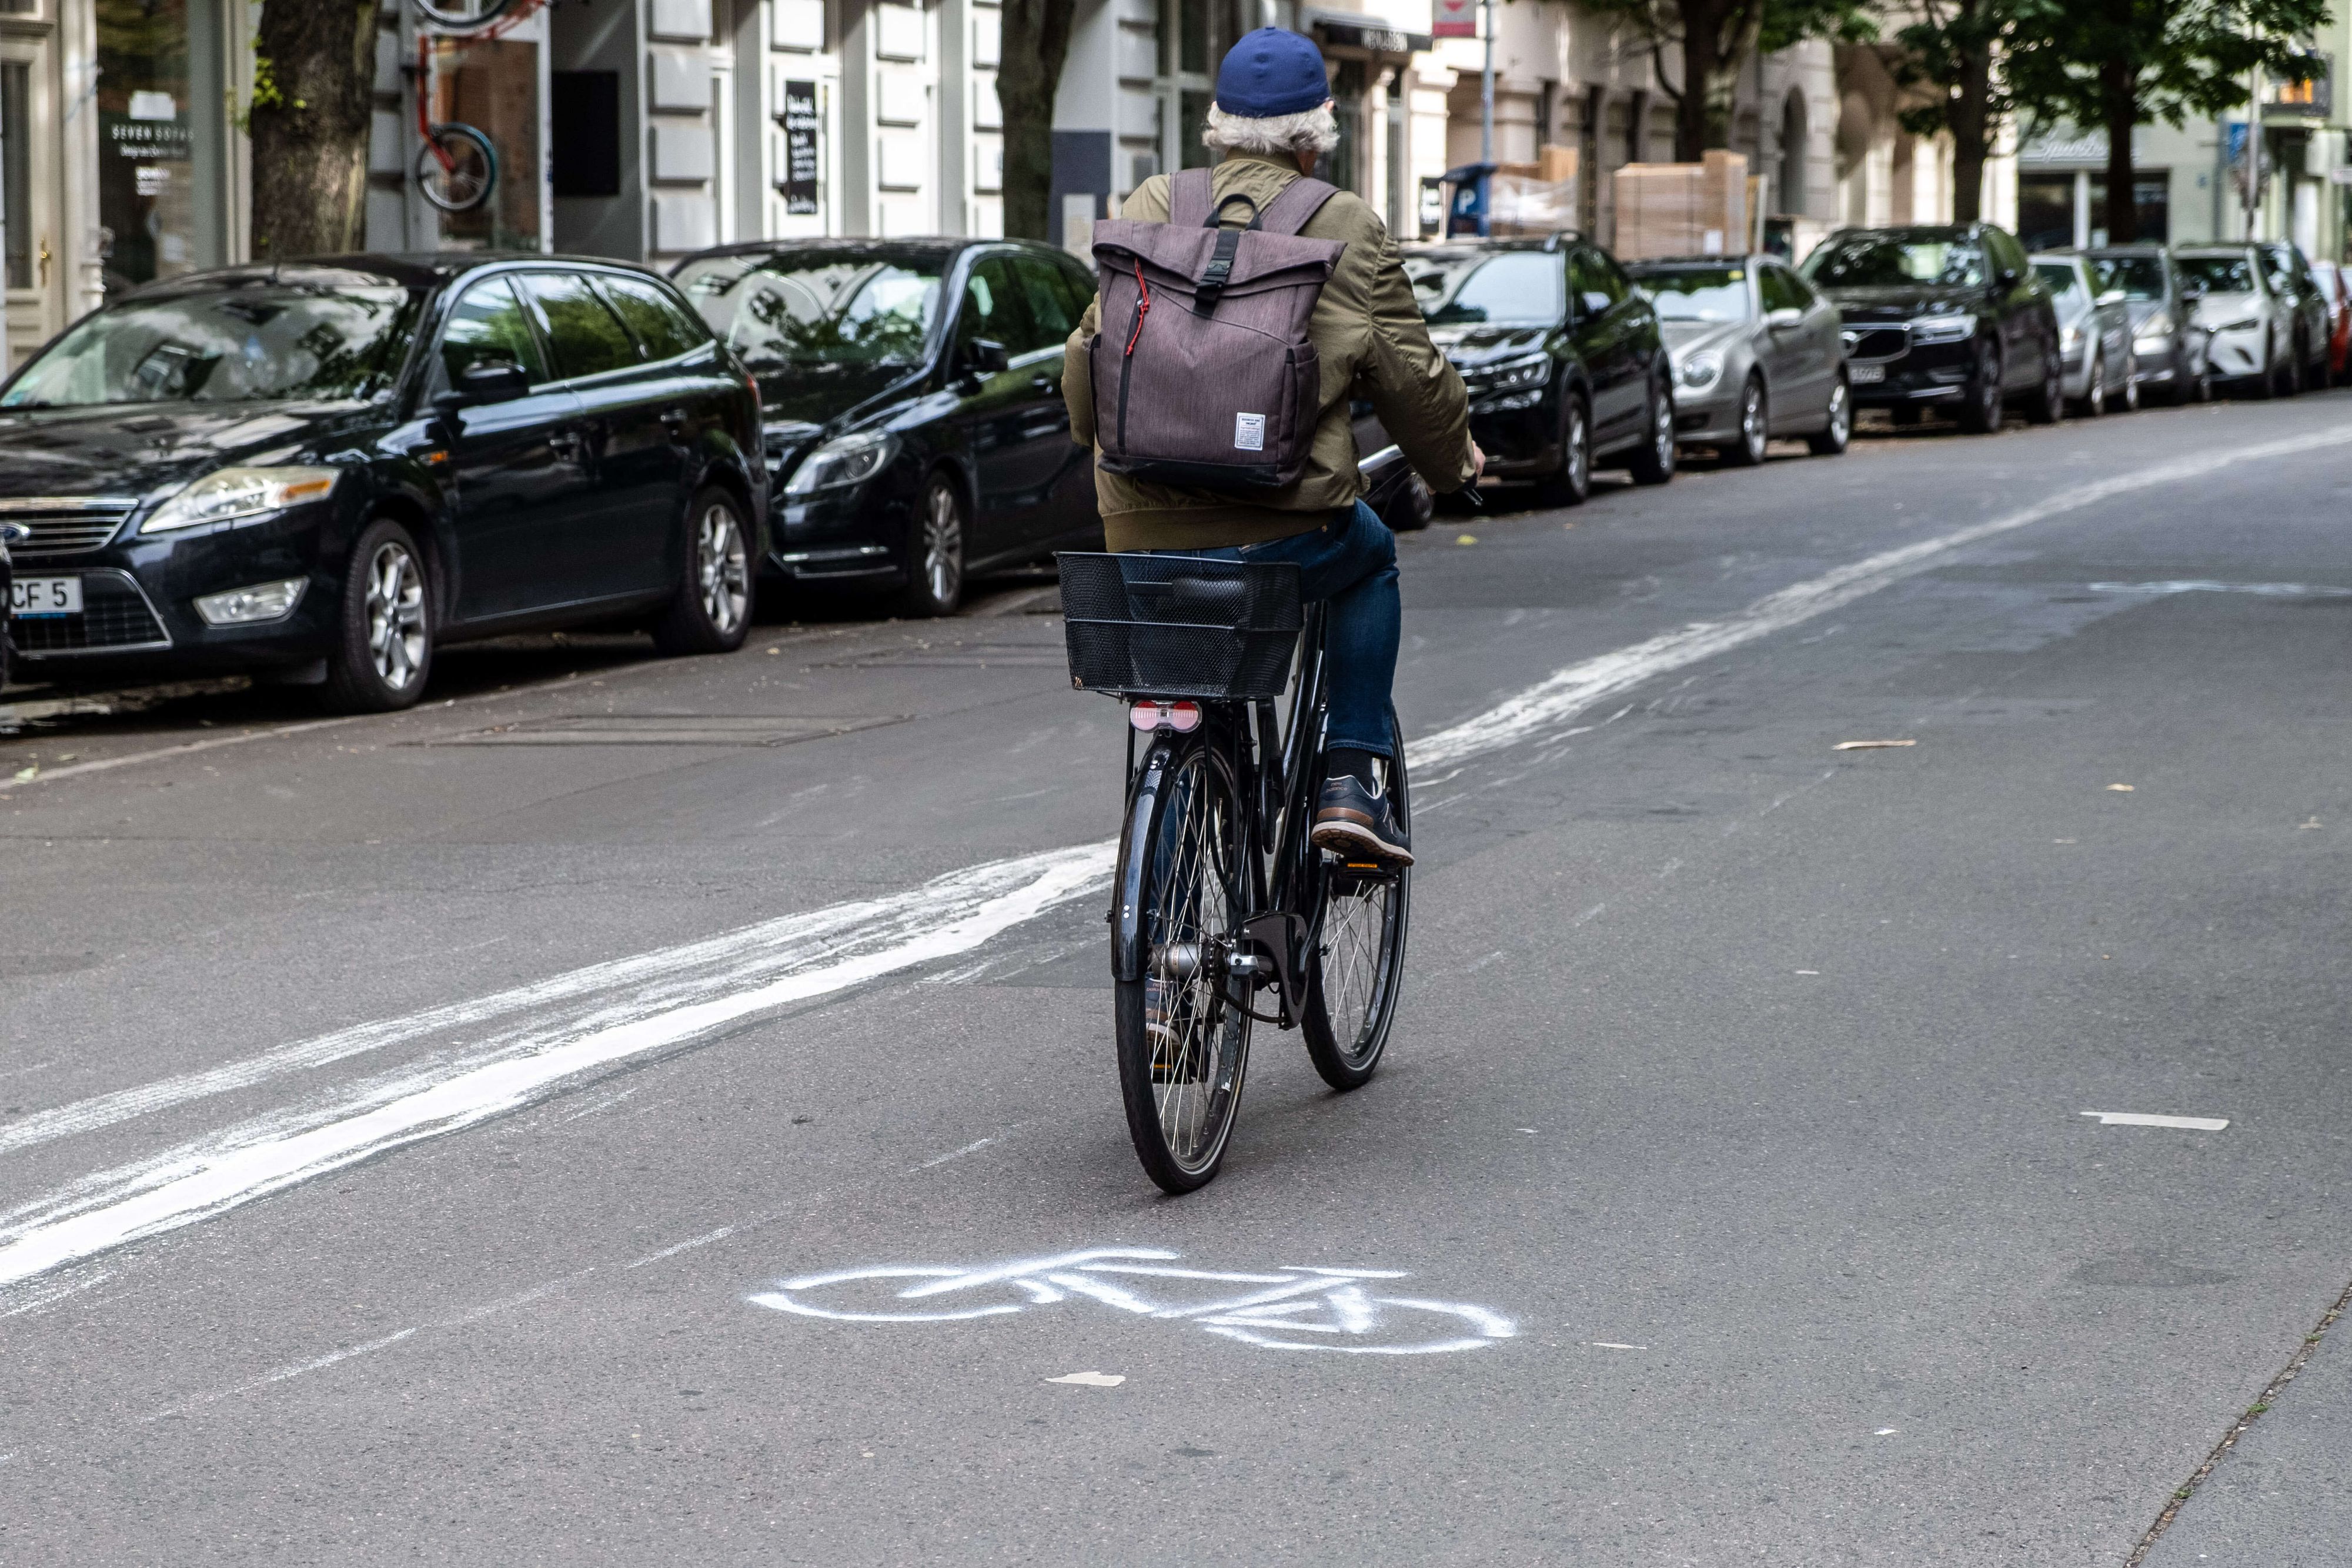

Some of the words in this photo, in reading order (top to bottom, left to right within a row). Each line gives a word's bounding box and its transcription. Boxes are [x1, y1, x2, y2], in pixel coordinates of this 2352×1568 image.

[111, 124, 152, 141] SEVEN
[1458, 189, 1476, 214] P
[52, 581, 67, 607] 5
